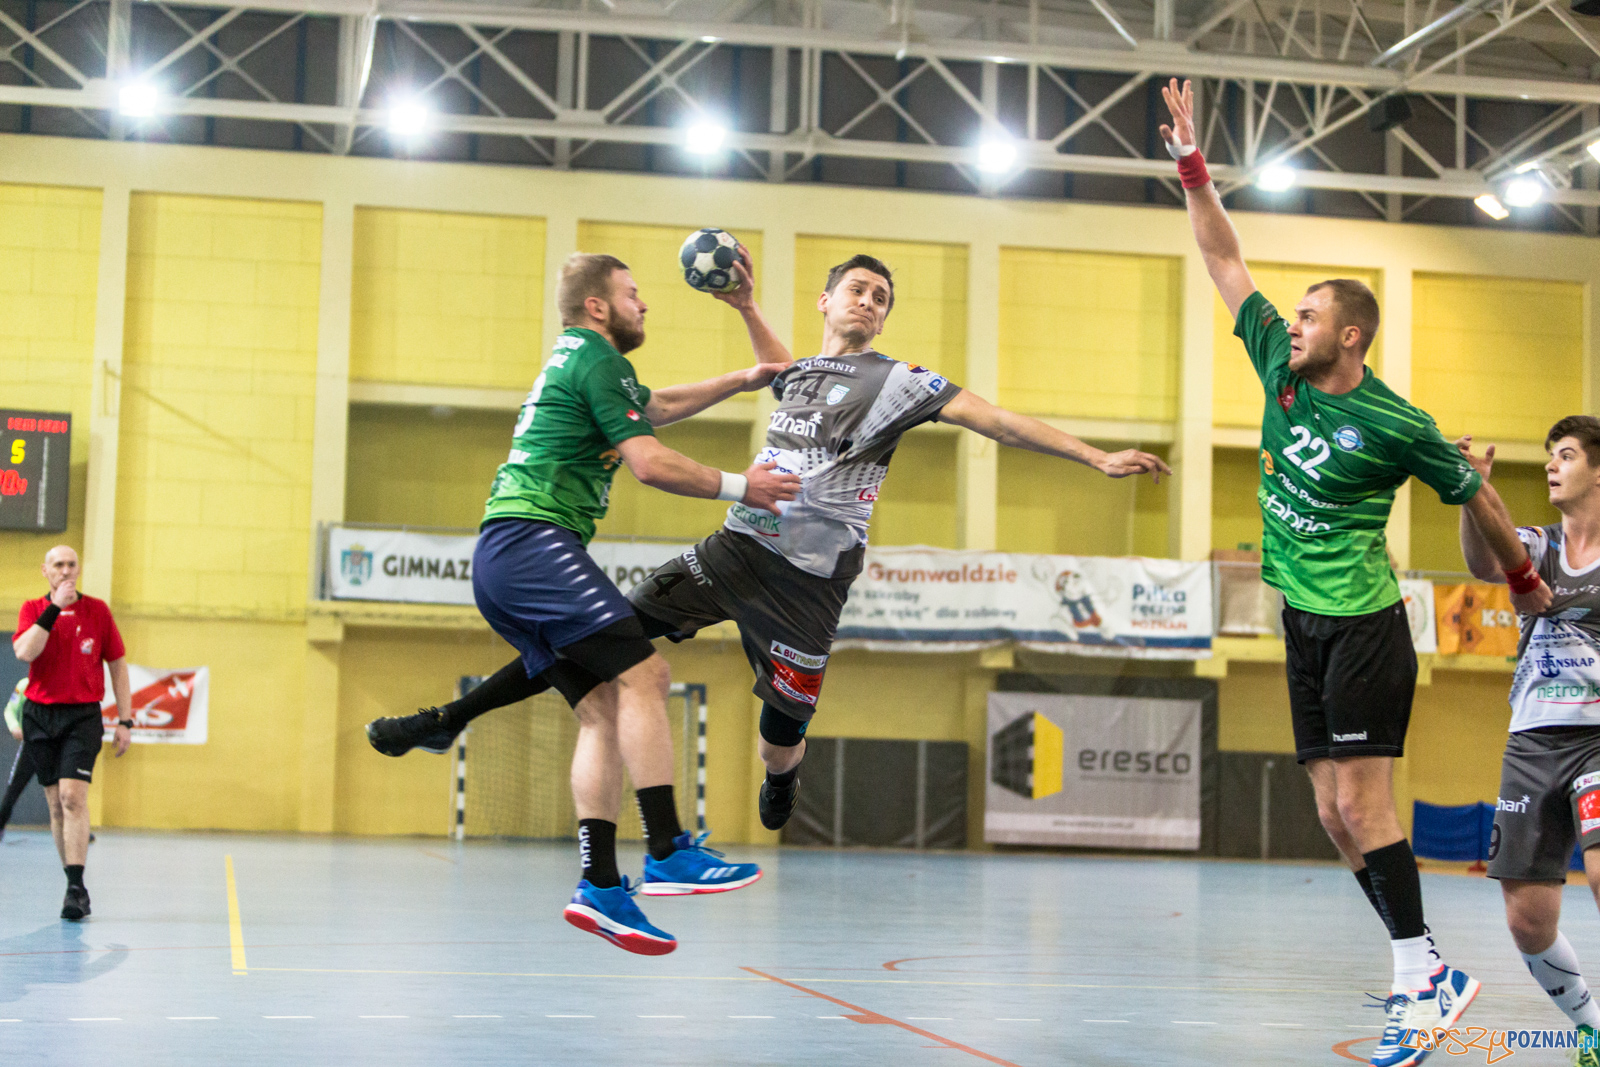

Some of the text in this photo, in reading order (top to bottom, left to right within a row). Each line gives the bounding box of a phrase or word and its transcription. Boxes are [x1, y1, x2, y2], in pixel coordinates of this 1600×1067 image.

[10, 438, 26, 464] 5
[1282, 425, 1331, 481] 22
[382, 554, 471, 580] GIMNAZ
[868, 561, 1017, 583] Grunwaldzie
[1535, 657, 1595, 669] TRANSKAP
[1078, 749, 1192, 775] eresco
